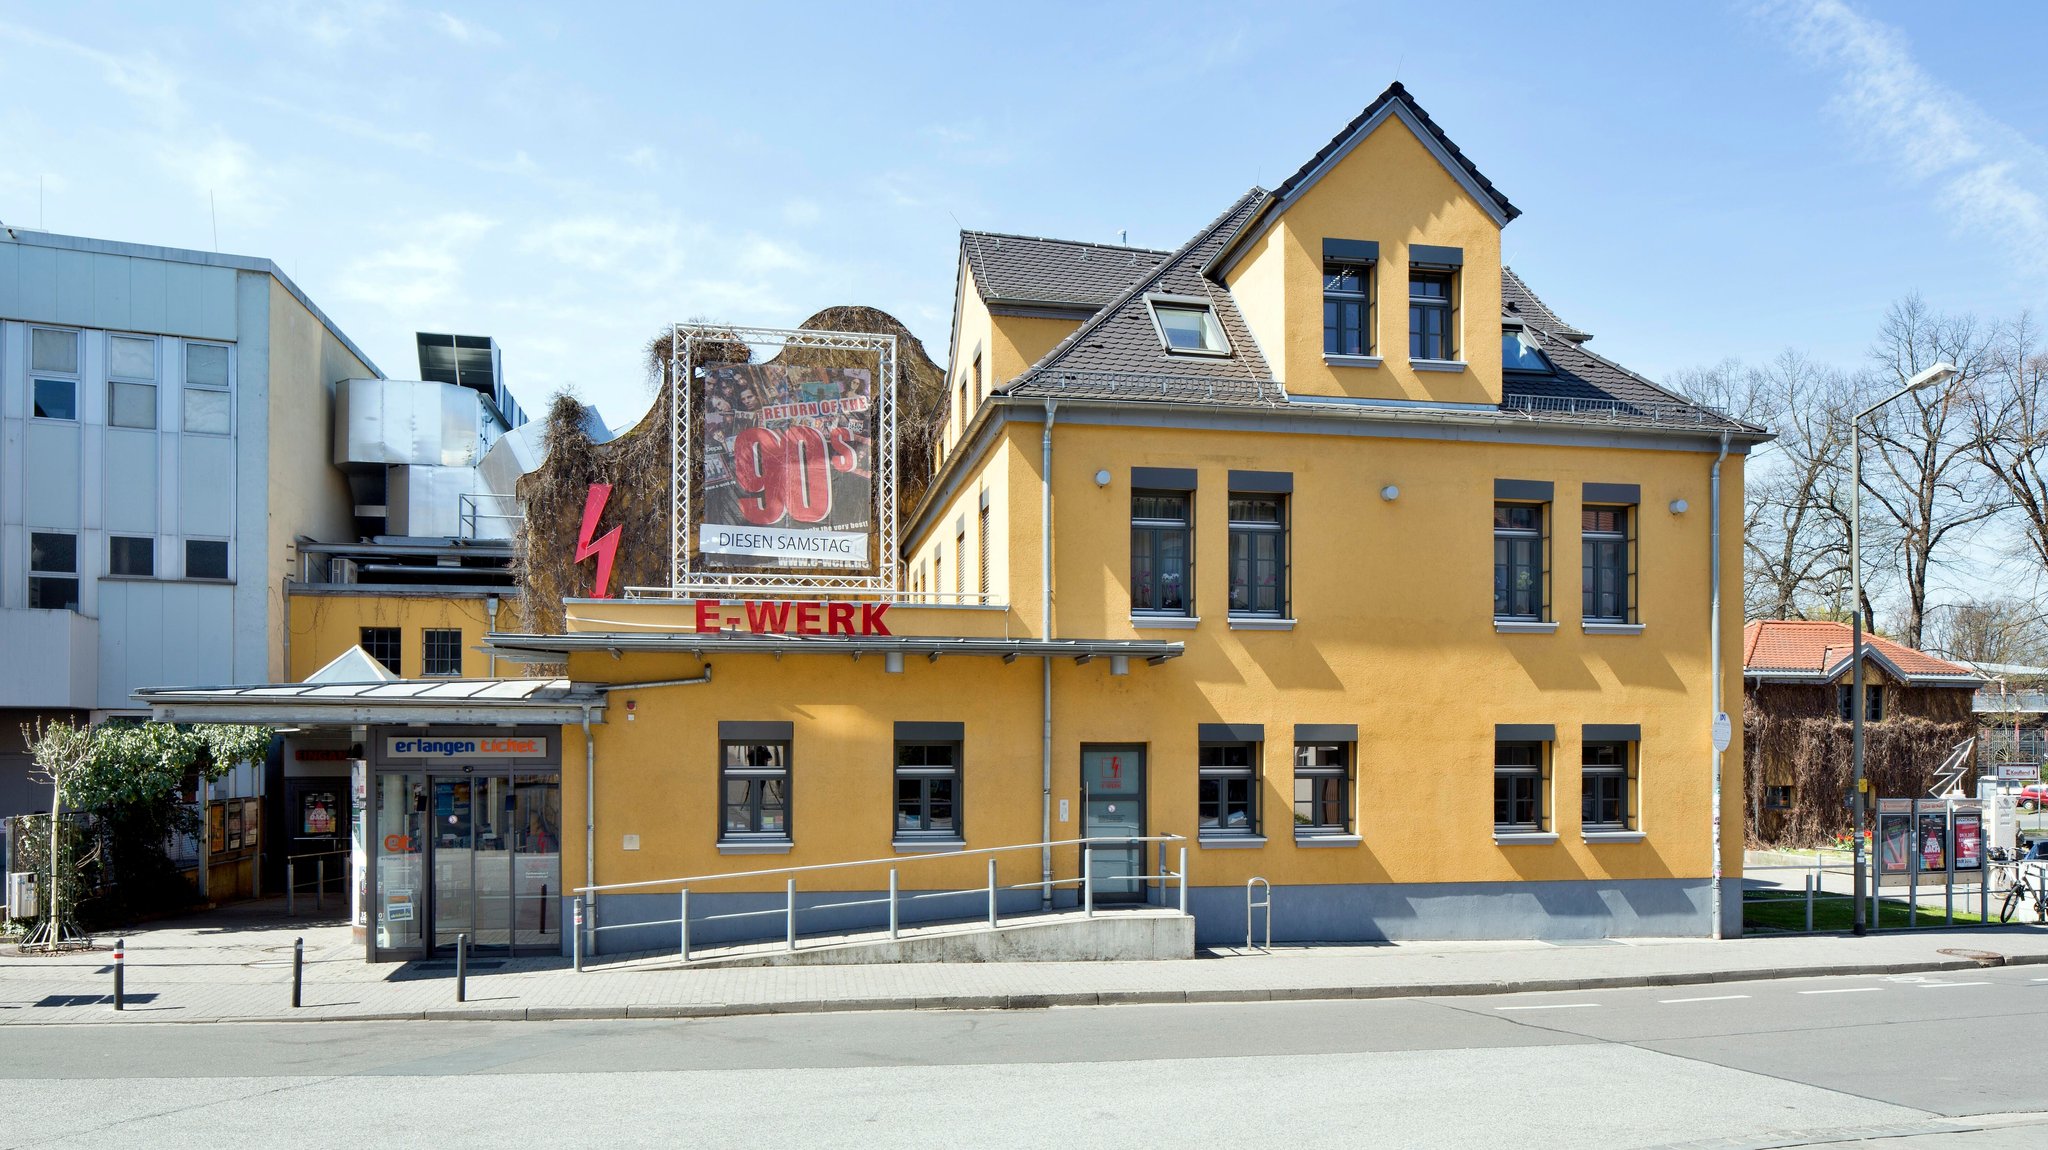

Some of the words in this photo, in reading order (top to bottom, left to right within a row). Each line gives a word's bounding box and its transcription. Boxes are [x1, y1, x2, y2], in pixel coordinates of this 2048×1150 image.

[763, 402, 819, 421] RETURN
[820, 399, 839, 415] OF
[840, 396, 869, 413] THE
[833, 523, 850, 532] very
[719, 532, 773, 548] DIESEN
[777, 536, 851, 554] SAMSTAG
[695, 600, 892, 636] E-WERK
[395, 739, 475, 756] erlangen
[480, 739, 539, 753] ticket
